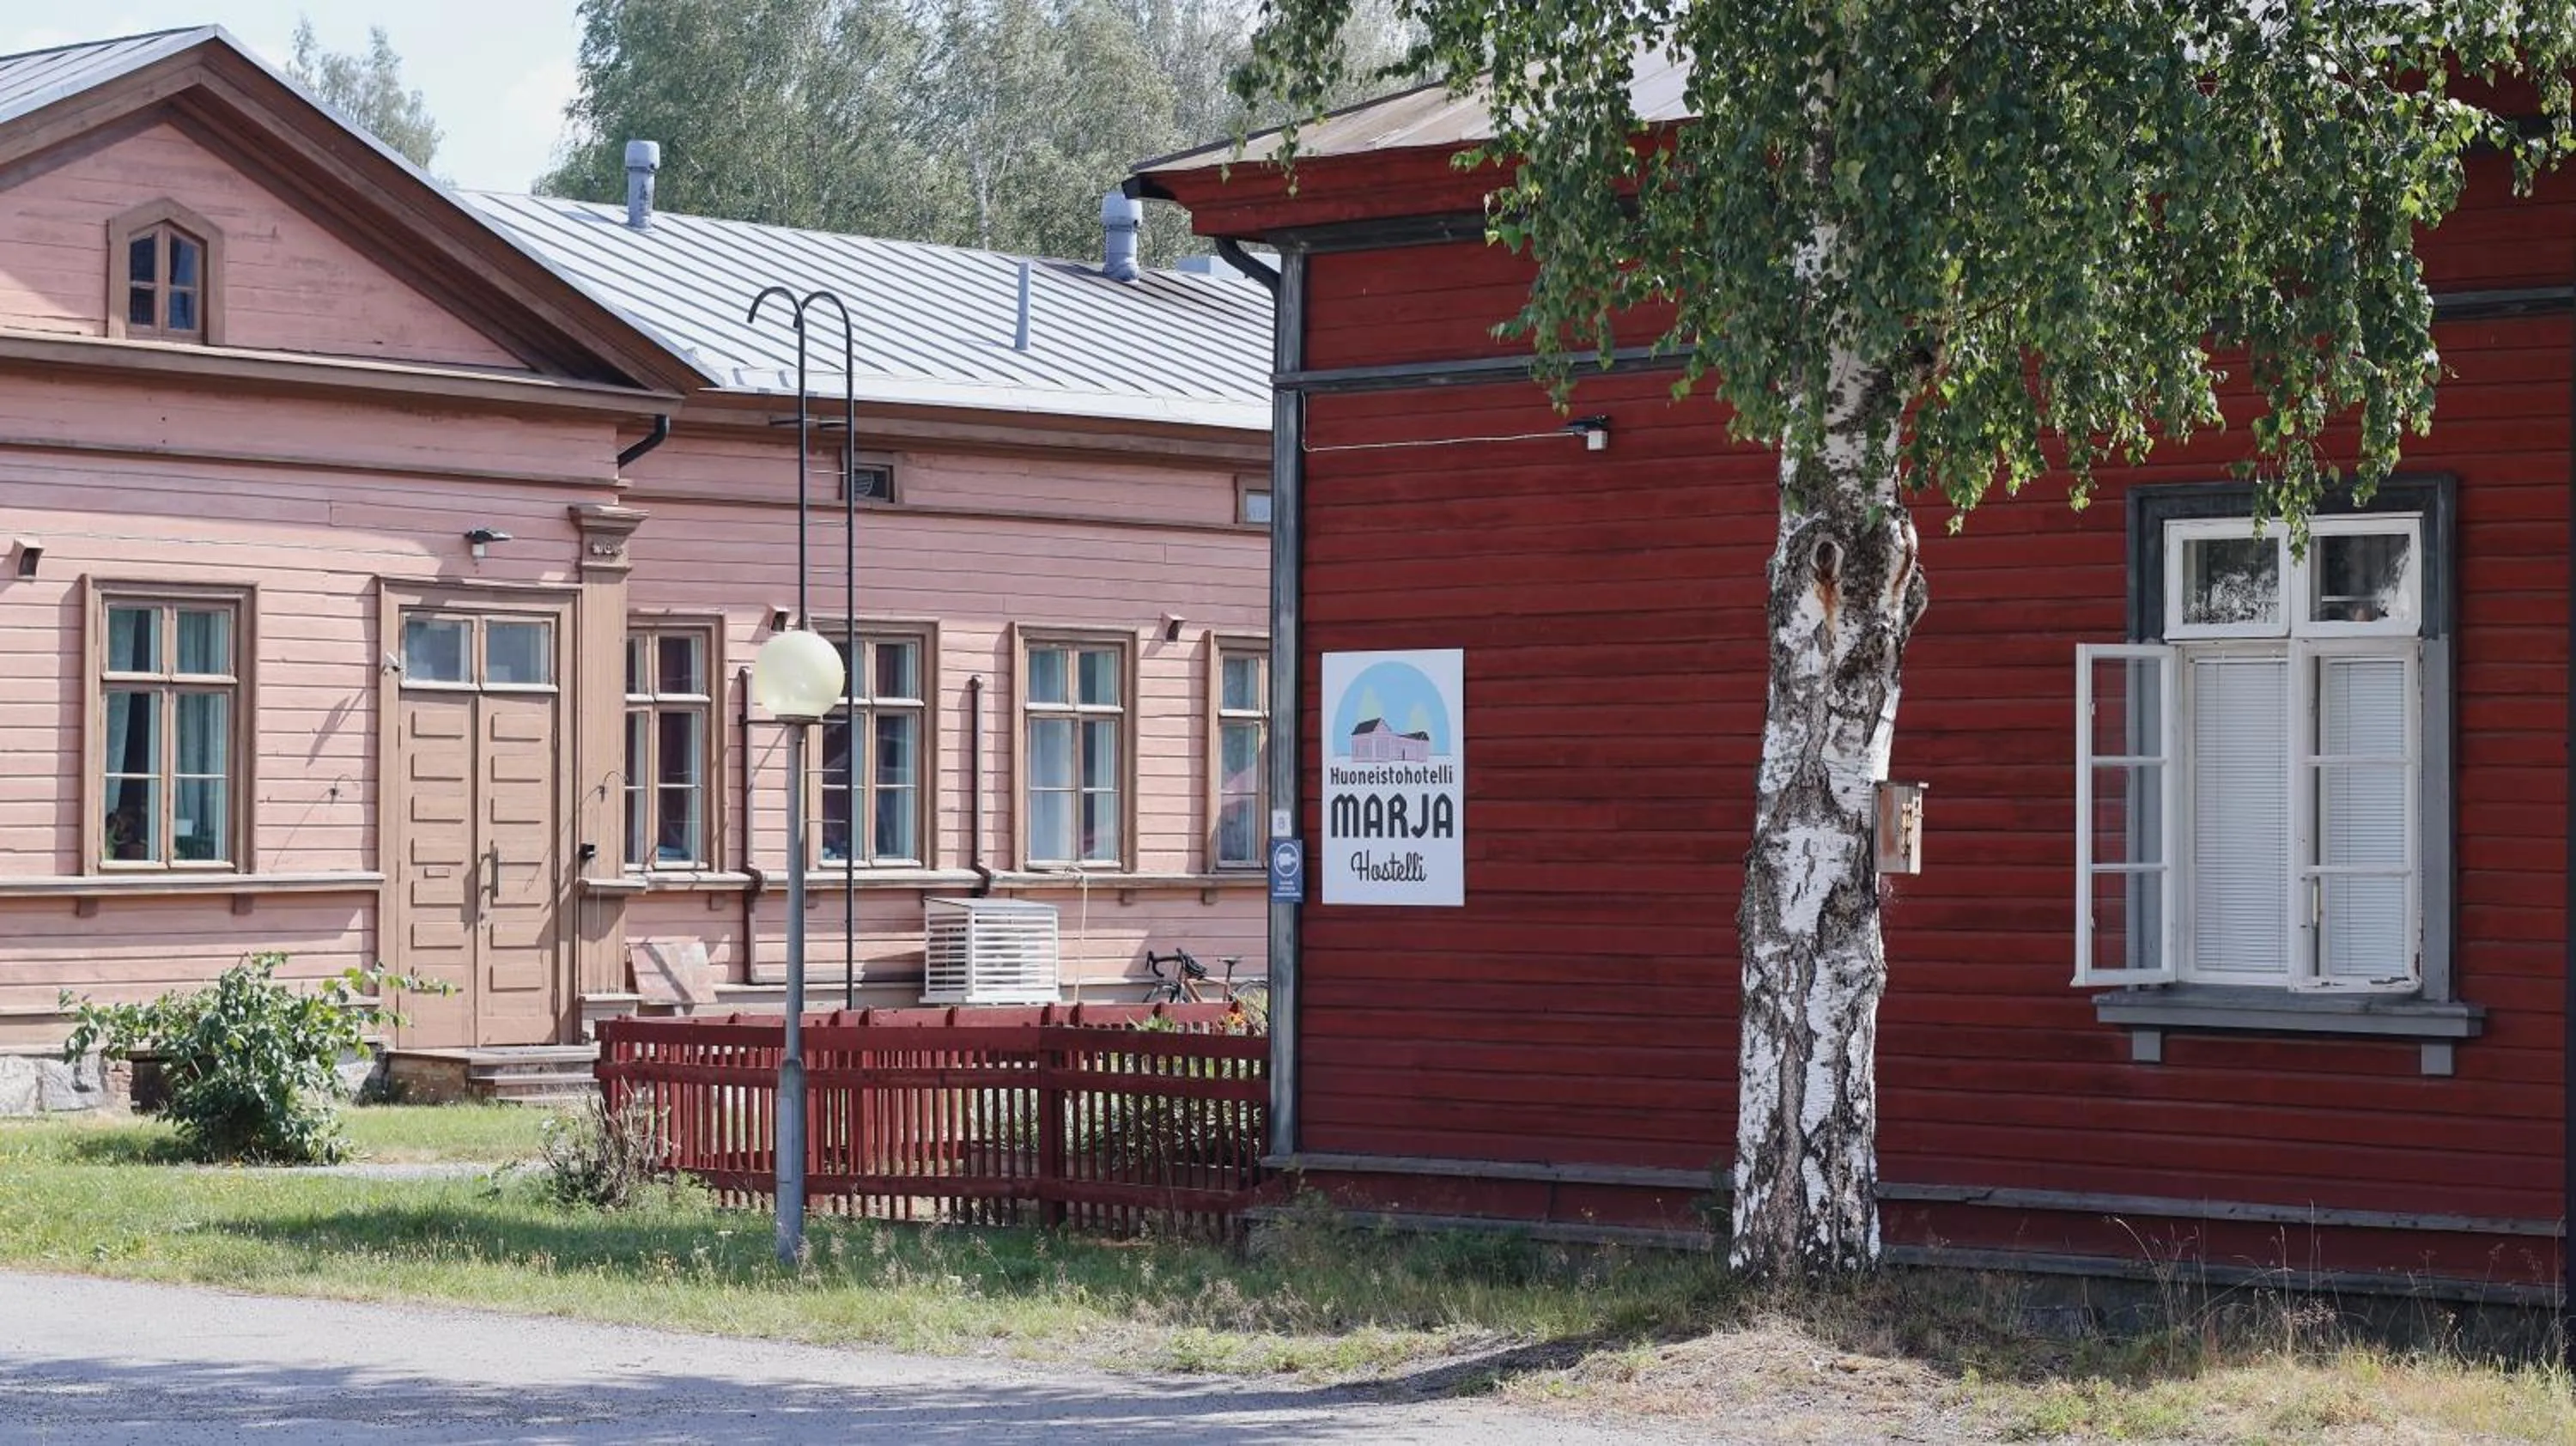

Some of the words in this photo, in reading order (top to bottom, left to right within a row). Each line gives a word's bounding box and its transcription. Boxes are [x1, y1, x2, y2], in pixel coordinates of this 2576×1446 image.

[1330, 765, 1454, 786] Huoneistohotelli
[1330, 793, 1454, 839] MARJA
[1351, 850, 1427, 882] Hostelli
